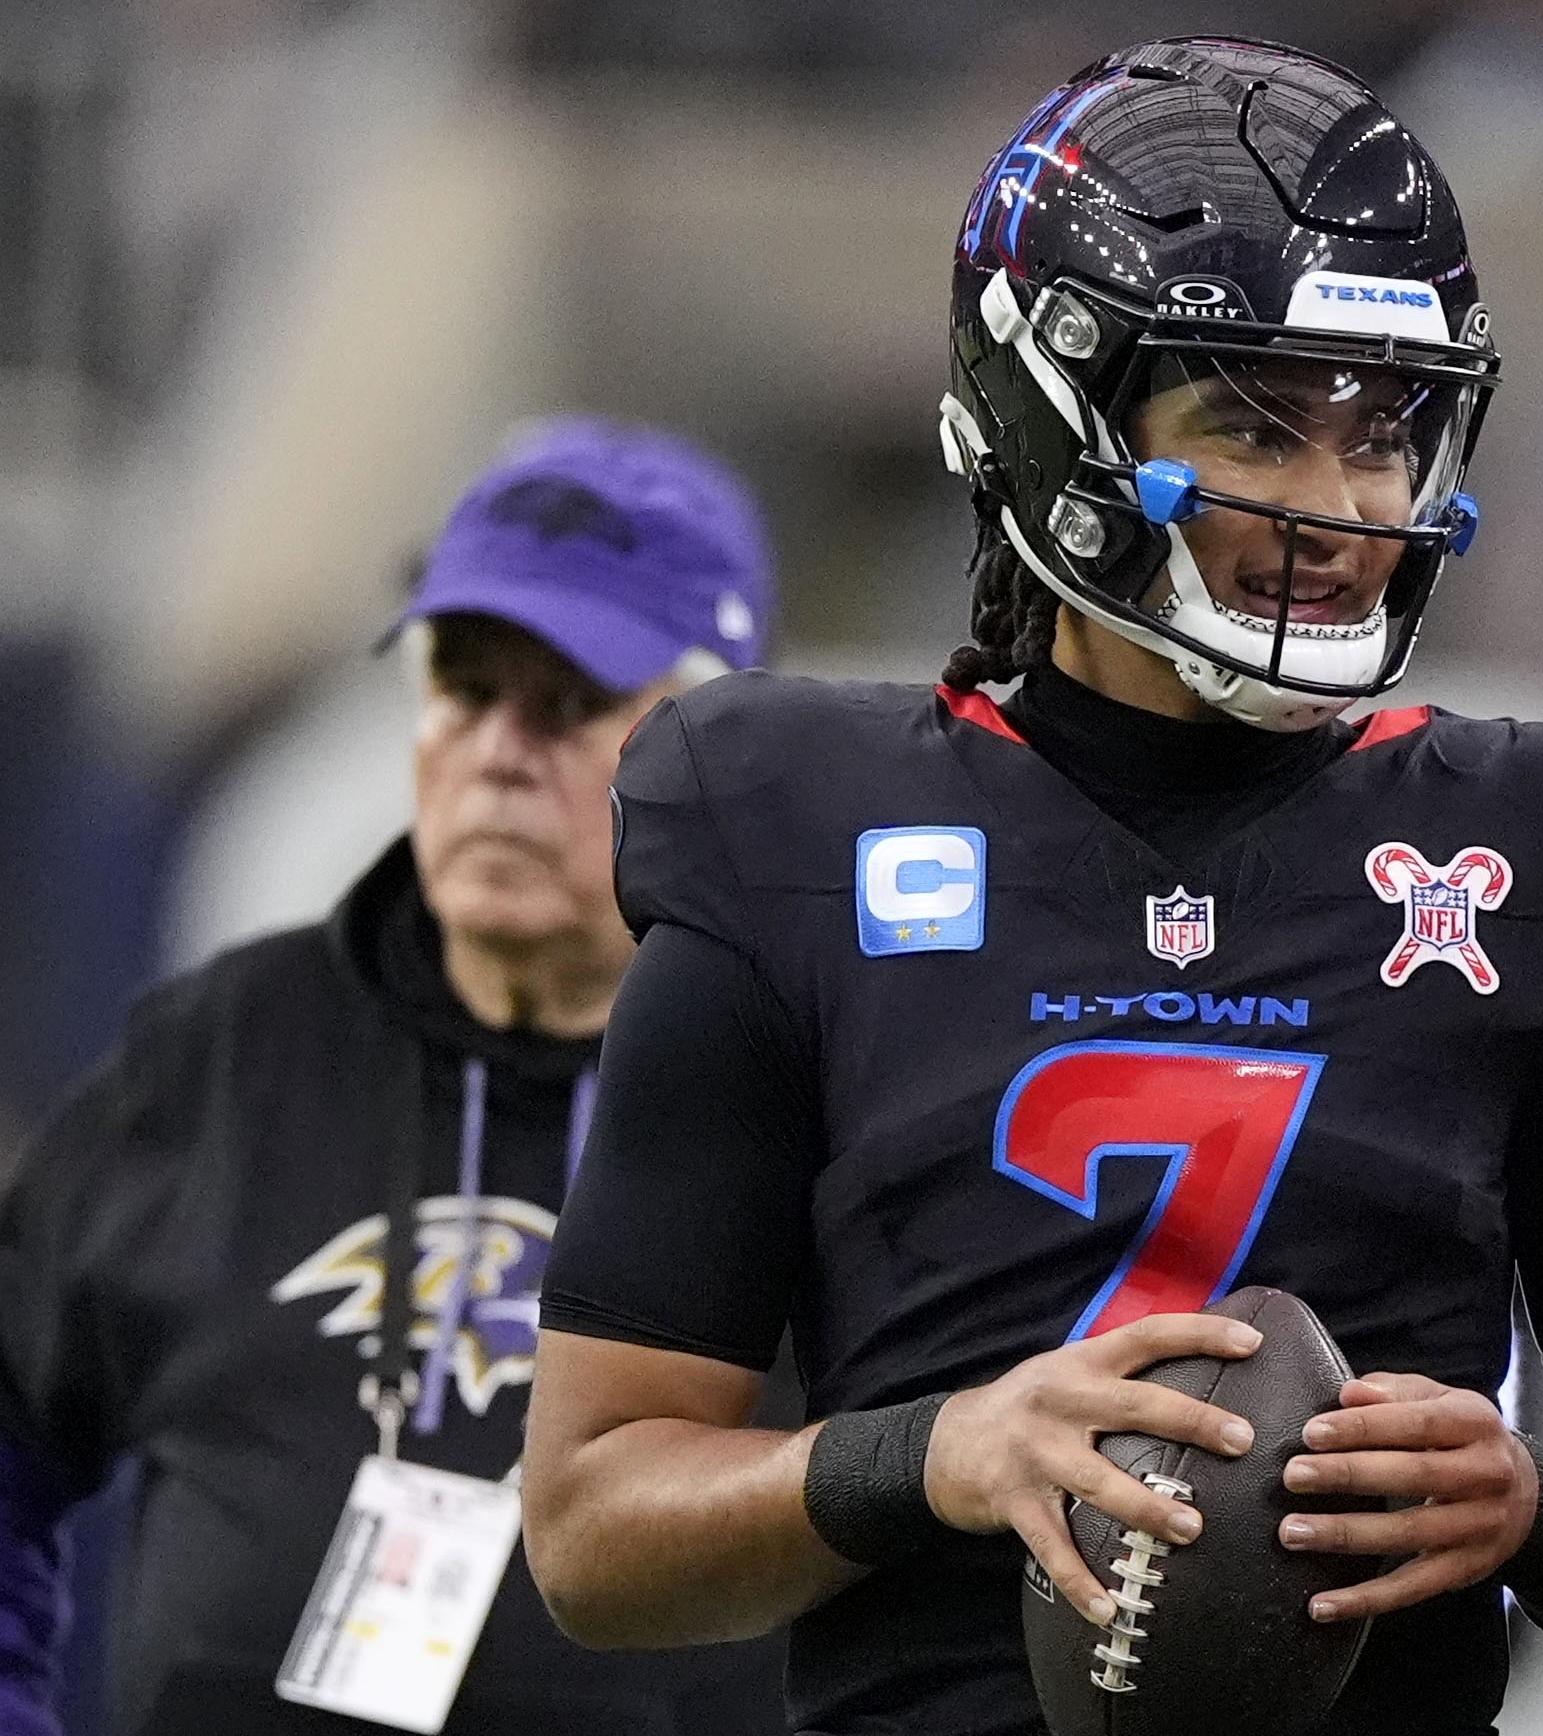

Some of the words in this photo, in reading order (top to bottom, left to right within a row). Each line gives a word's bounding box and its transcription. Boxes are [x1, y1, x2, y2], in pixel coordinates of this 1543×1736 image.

[1157, 303, 1237, 319] OAKLEY
[1315, 284, 1433, 308] TEXANS
[866, 834, 976, 921] C
[1160, 924, 1203, 953] NFL
[1417, 908, 1463, 942] NFL
[1030, 991, 1310, 1027] H-TOWN
[993, 1039, 1329, 1345] 7
